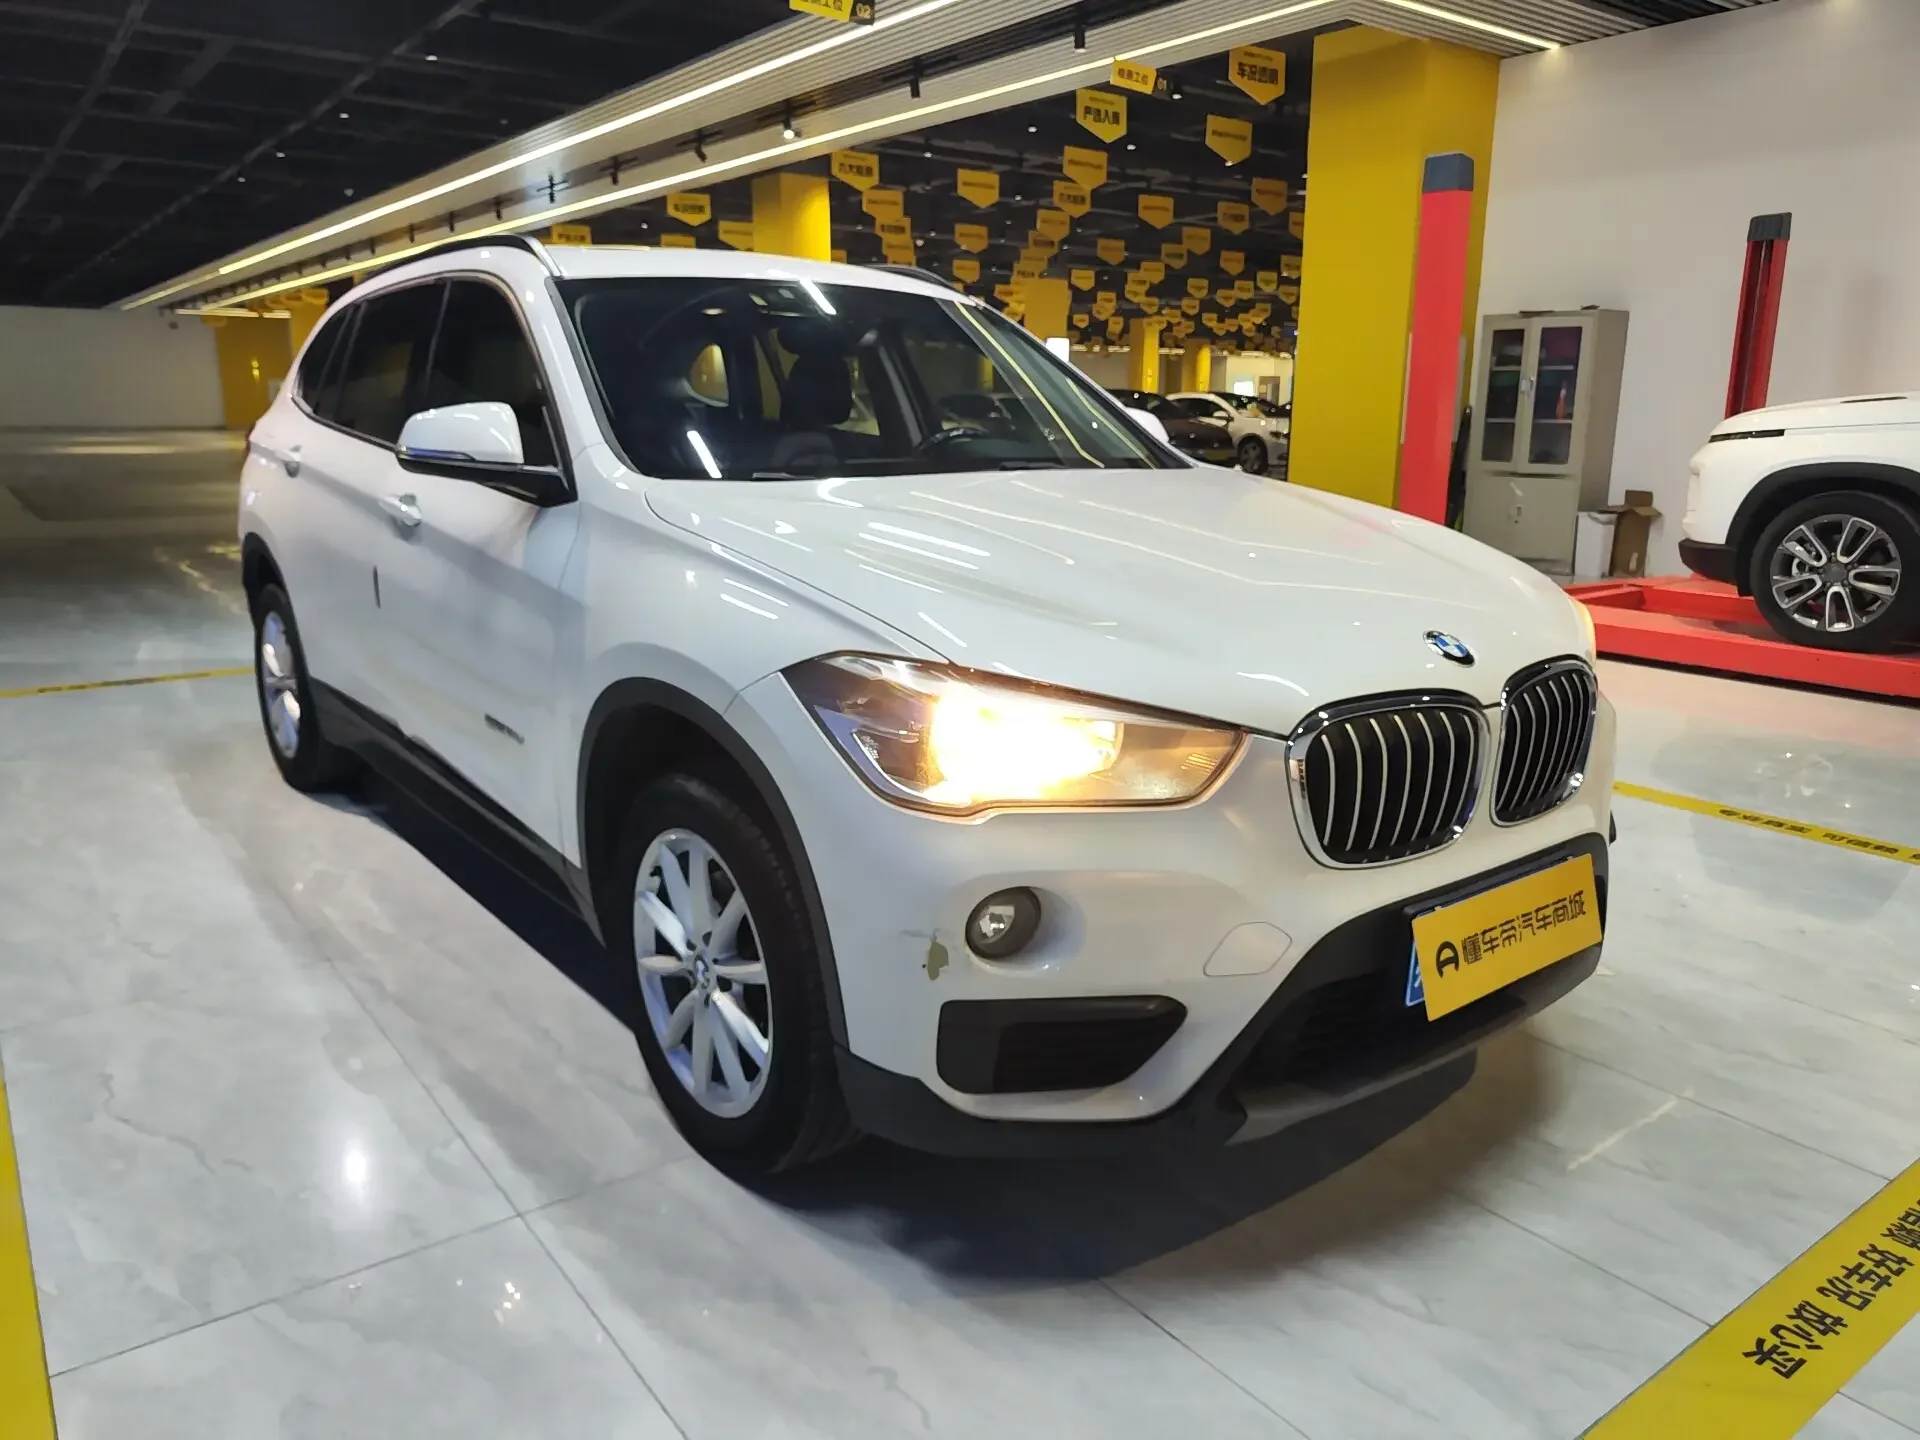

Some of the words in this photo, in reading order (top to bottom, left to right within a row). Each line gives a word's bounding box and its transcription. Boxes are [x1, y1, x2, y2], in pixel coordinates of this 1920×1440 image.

[856, 3, 872, 19] 02
[1461, 889, 1587, 965] 懂车帝汽车商城
[1816, 1243, 1915, 1311] 好车况
[1742, 1300, 1848, 1380] 放心买
